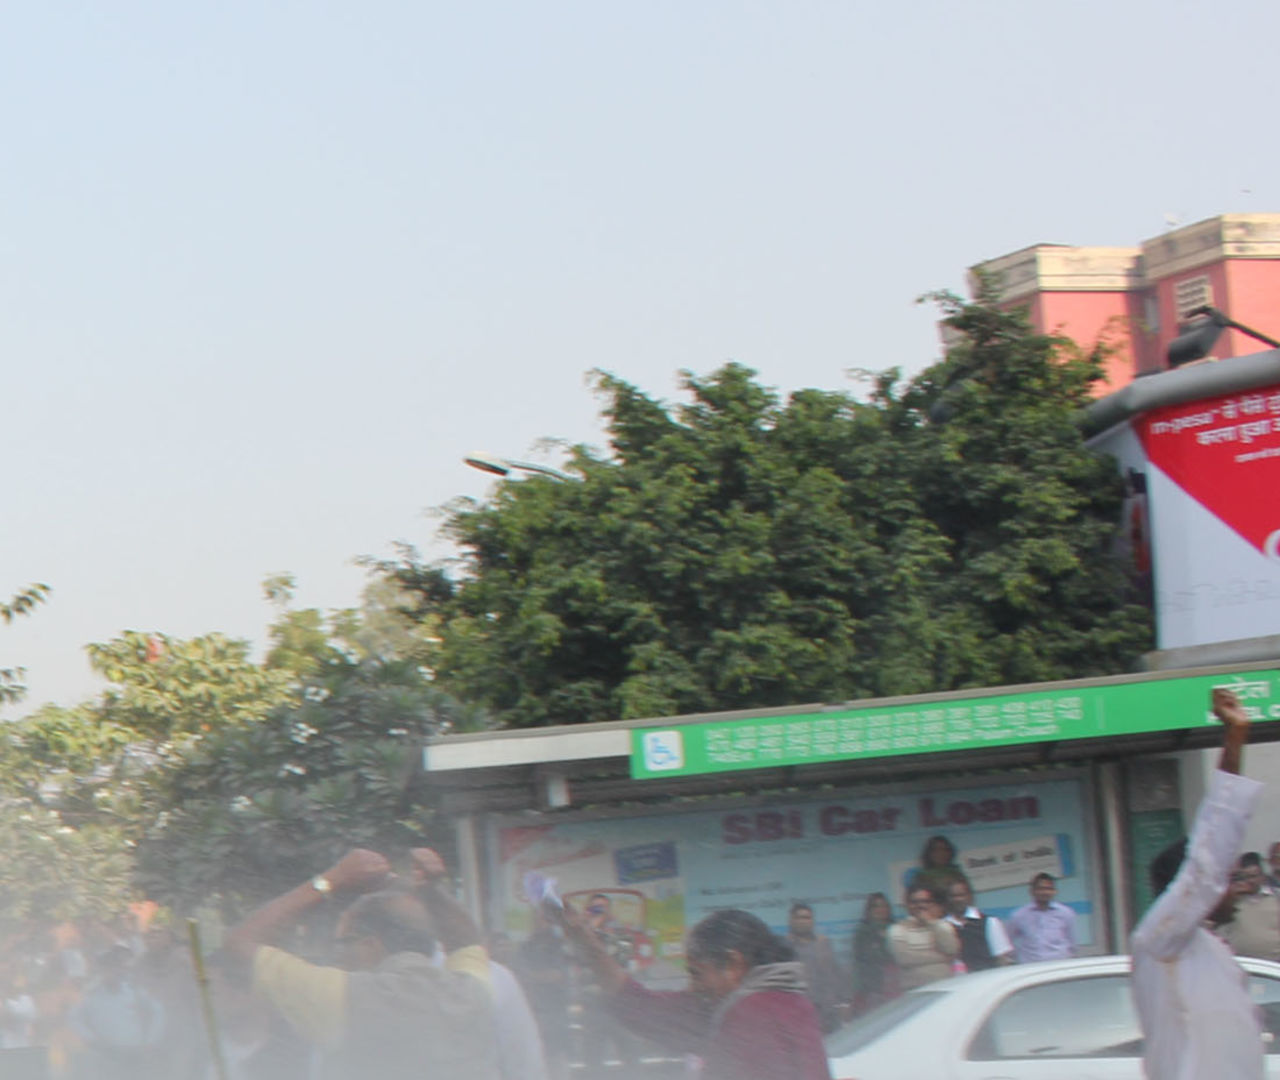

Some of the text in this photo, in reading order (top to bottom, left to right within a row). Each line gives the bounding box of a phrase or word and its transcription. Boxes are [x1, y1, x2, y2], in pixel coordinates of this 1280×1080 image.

[721, 796, 1039, 845] SBI Car Loan
